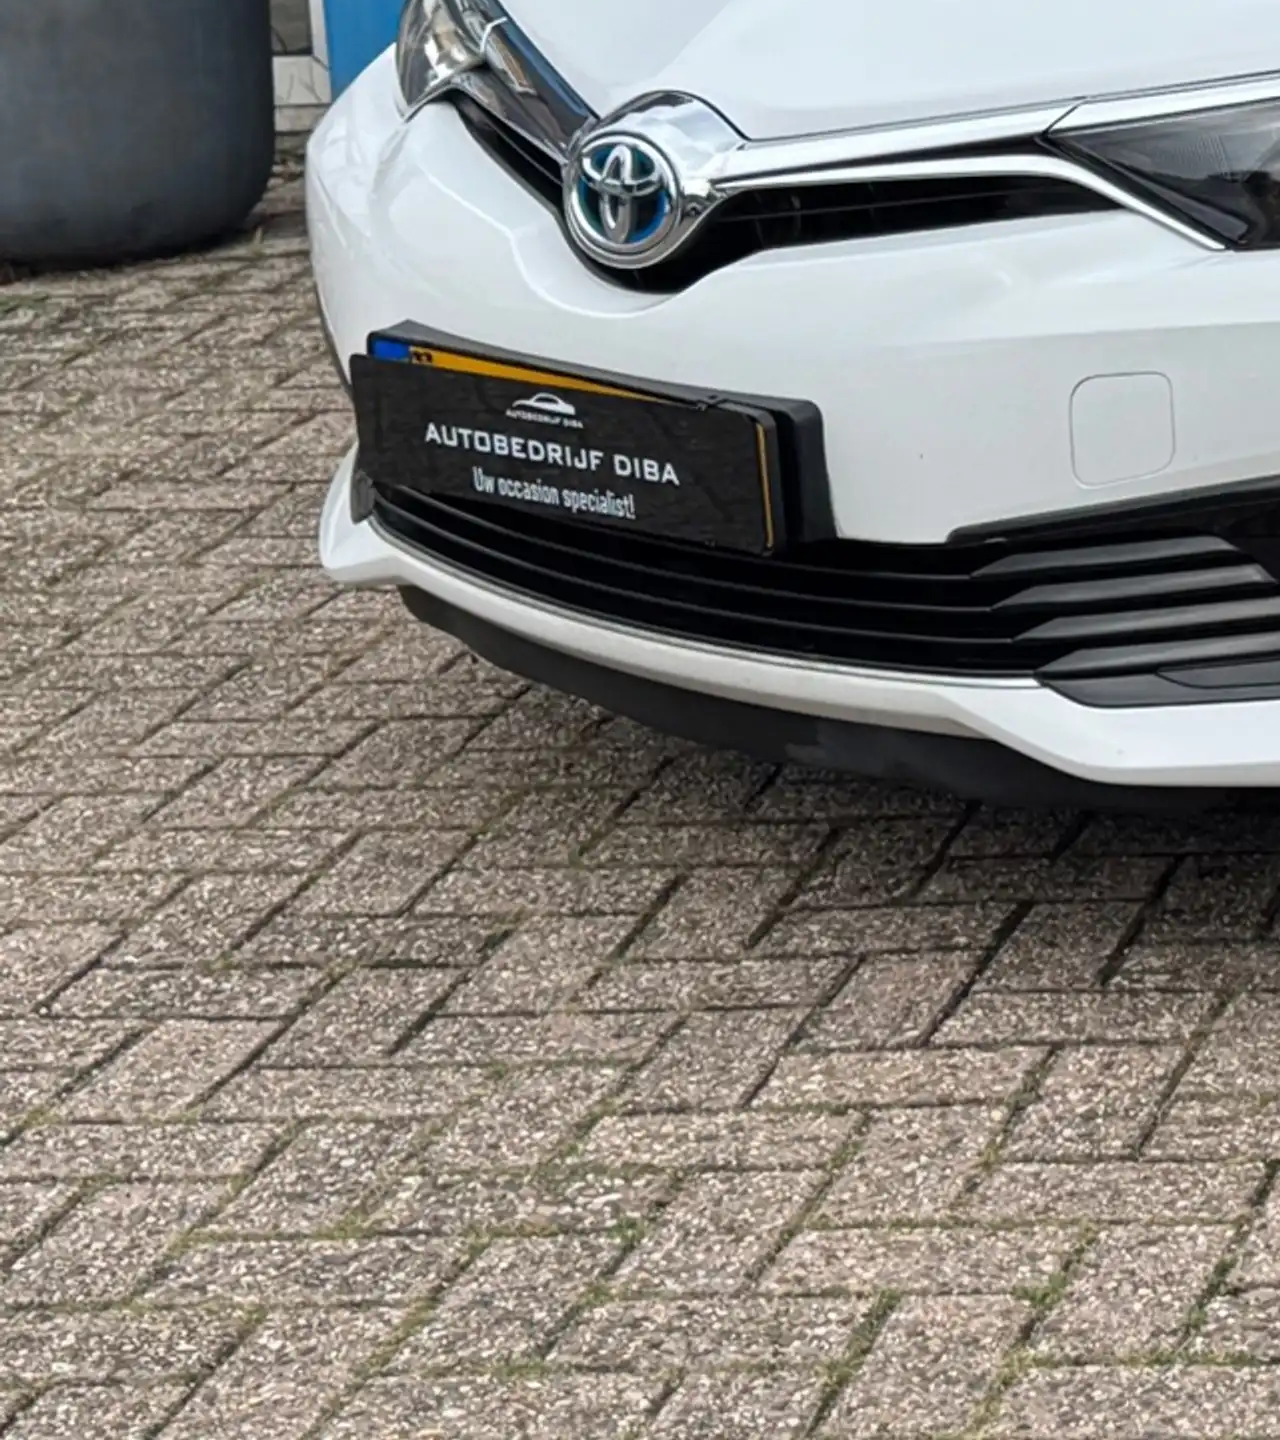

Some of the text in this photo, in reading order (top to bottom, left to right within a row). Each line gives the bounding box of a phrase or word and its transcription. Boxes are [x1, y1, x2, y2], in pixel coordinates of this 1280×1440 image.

[425, 422, 680, 486] AUTOBEDRIJF DIBA
[472, 466, 637, 520] Uw occasion specialist!
